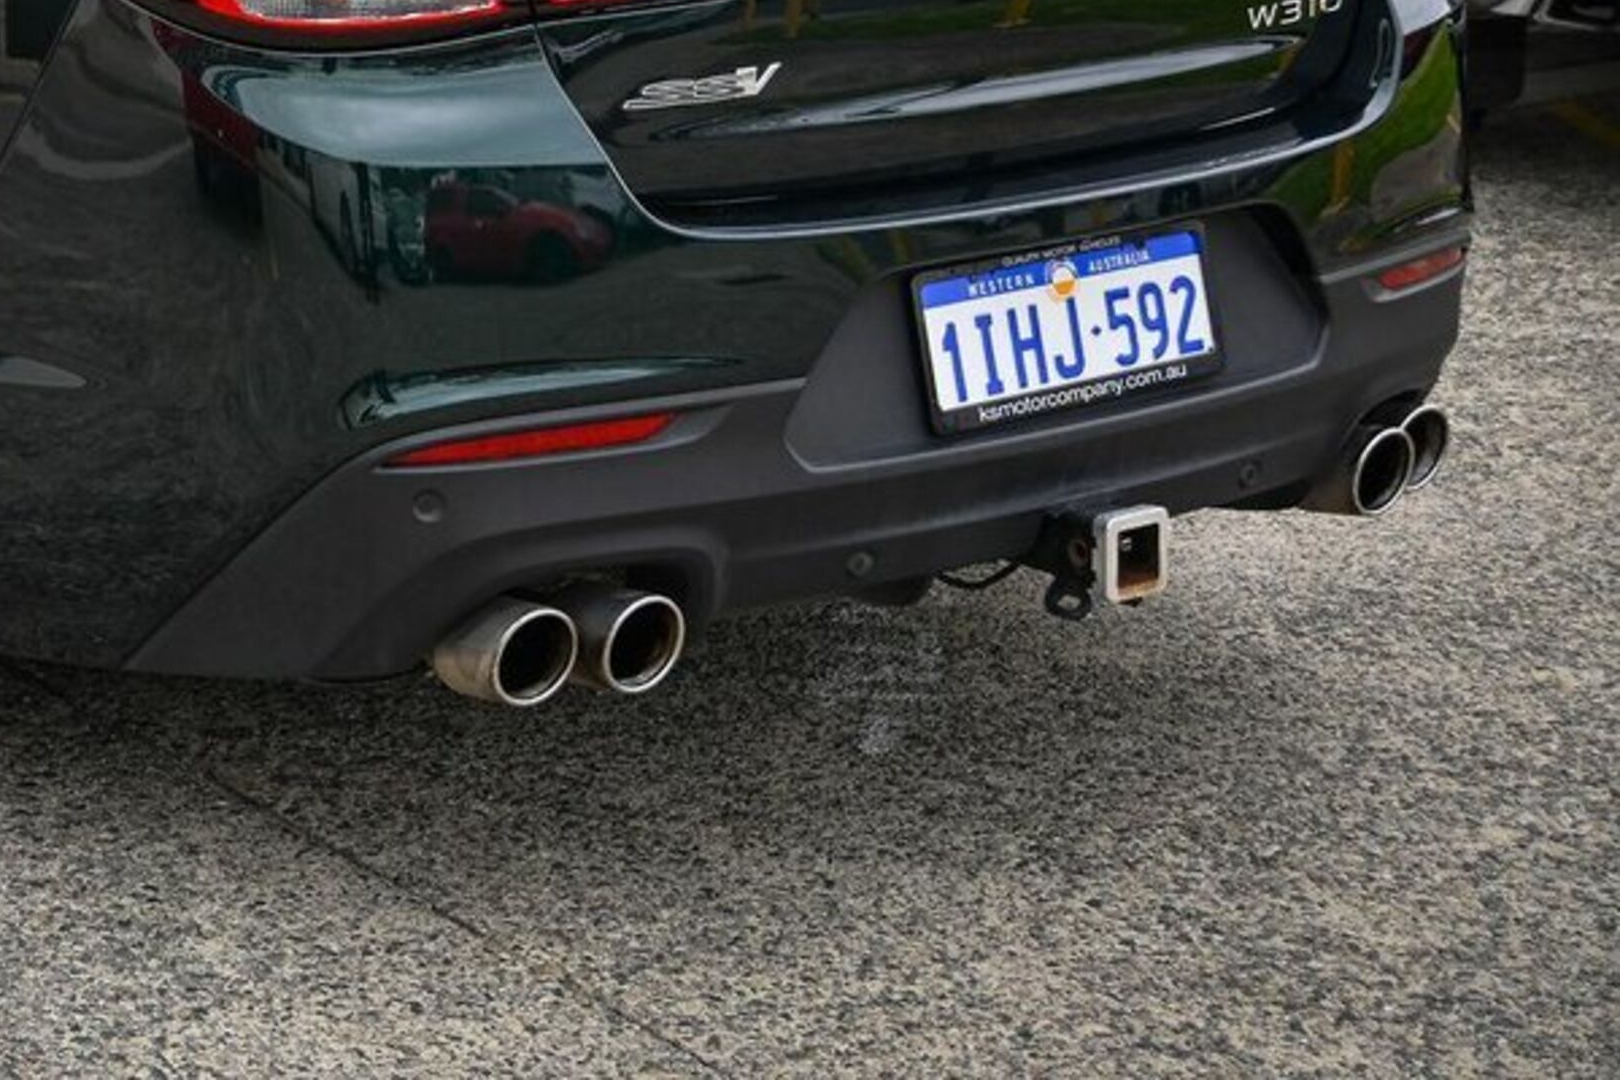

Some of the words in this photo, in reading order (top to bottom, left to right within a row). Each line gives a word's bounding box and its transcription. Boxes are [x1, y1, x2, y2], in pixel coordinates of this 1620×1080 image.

[968, 274, 1035, 297] WESTERN
[1088, 249, 1152, 273] AUSTRALIA
[980, 363, 1188, 422] ksmotorcompany.com.au
